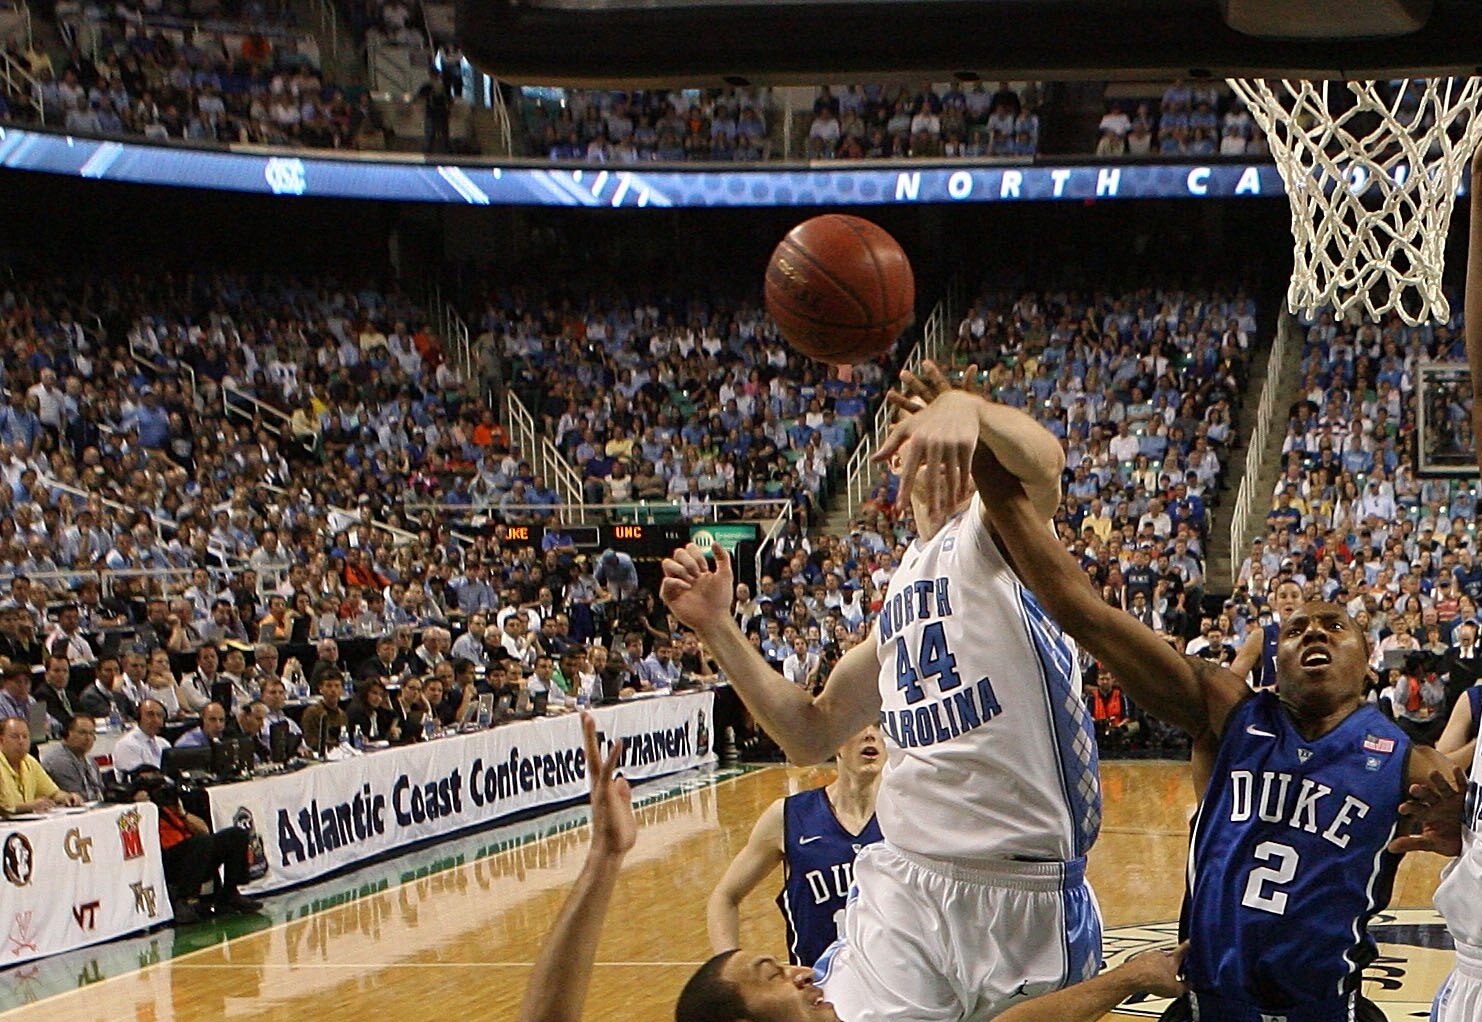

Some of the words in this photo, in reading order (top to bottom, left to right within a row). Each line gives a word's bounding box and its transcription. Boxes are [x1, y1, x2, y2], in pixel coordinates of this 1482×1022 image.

[895, 168, 1121, 199] NORTH
[615, 526, 642, 539] UNC
[879, 577, 953, 645] NORTH
[896, 621, 962, 705] 44
[277, 783, 386, 867] Atlantic
[392, 766, 463, 828] Coast
[470, 747, 587, 807] Conference
[1230, 770, 1371, 849] DUKE
[806, 862, 852, 905] DU
[1242, 841, 1300, 916] 2
[73, 901, 100, 932] VT
